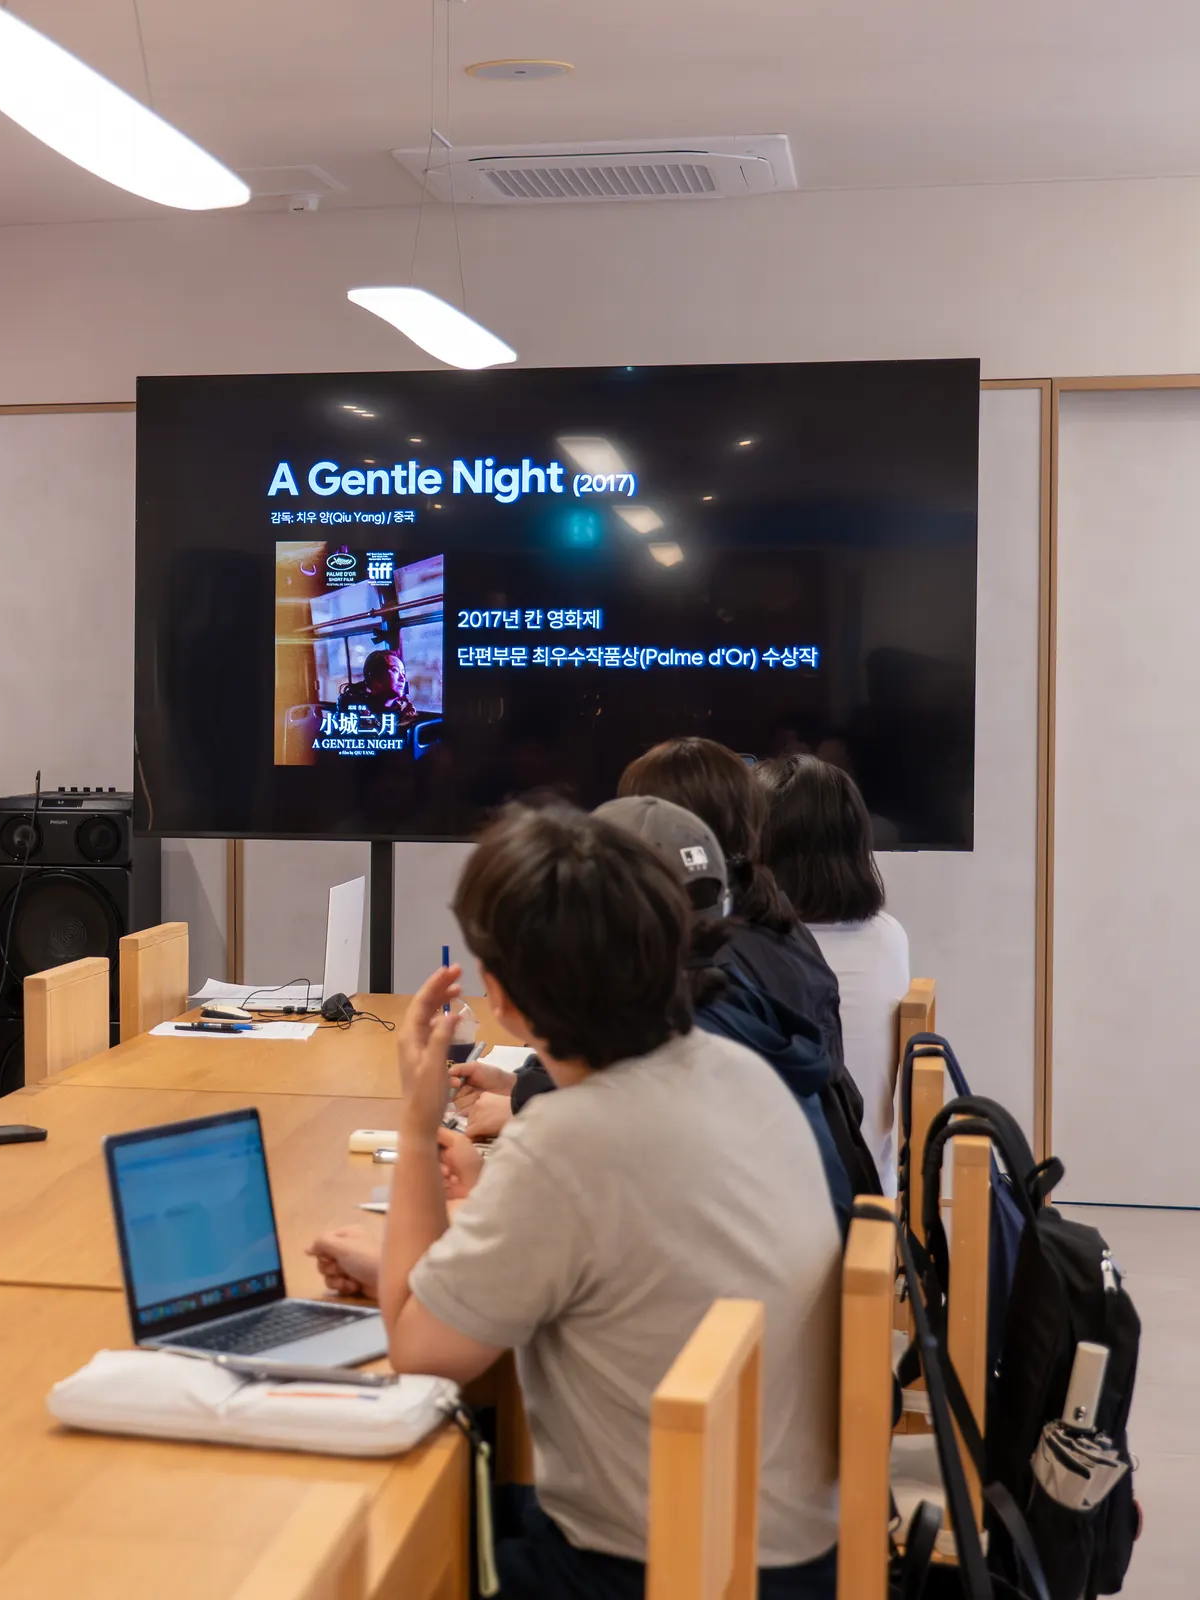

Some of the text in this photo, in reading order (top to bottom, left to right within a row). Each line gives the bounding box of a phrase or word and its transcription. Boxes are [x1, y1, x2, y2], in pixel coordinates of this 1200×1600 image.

[267, 458, 635, 504] A Gentle Night (2017)
[270, 512, 294, 524] 감독:
[296, 512, 317, 524] 치우
[319, 511, 352, 525] 양(Qiu
[355, 511, 385, 525] Yang)
[393, 511, 415, 523] 중국
[367, 562, 393, 579] tiff
[457, 609, 601, 630] 2017년 칸 영화제
[457, 646, 818, 669] 단편부문 최우수작품상(Palme d'Or) 수상작
[319, 712, 396, 736] 小城二月
[312, 738, 403, 749] A GENTLE NIGHT
